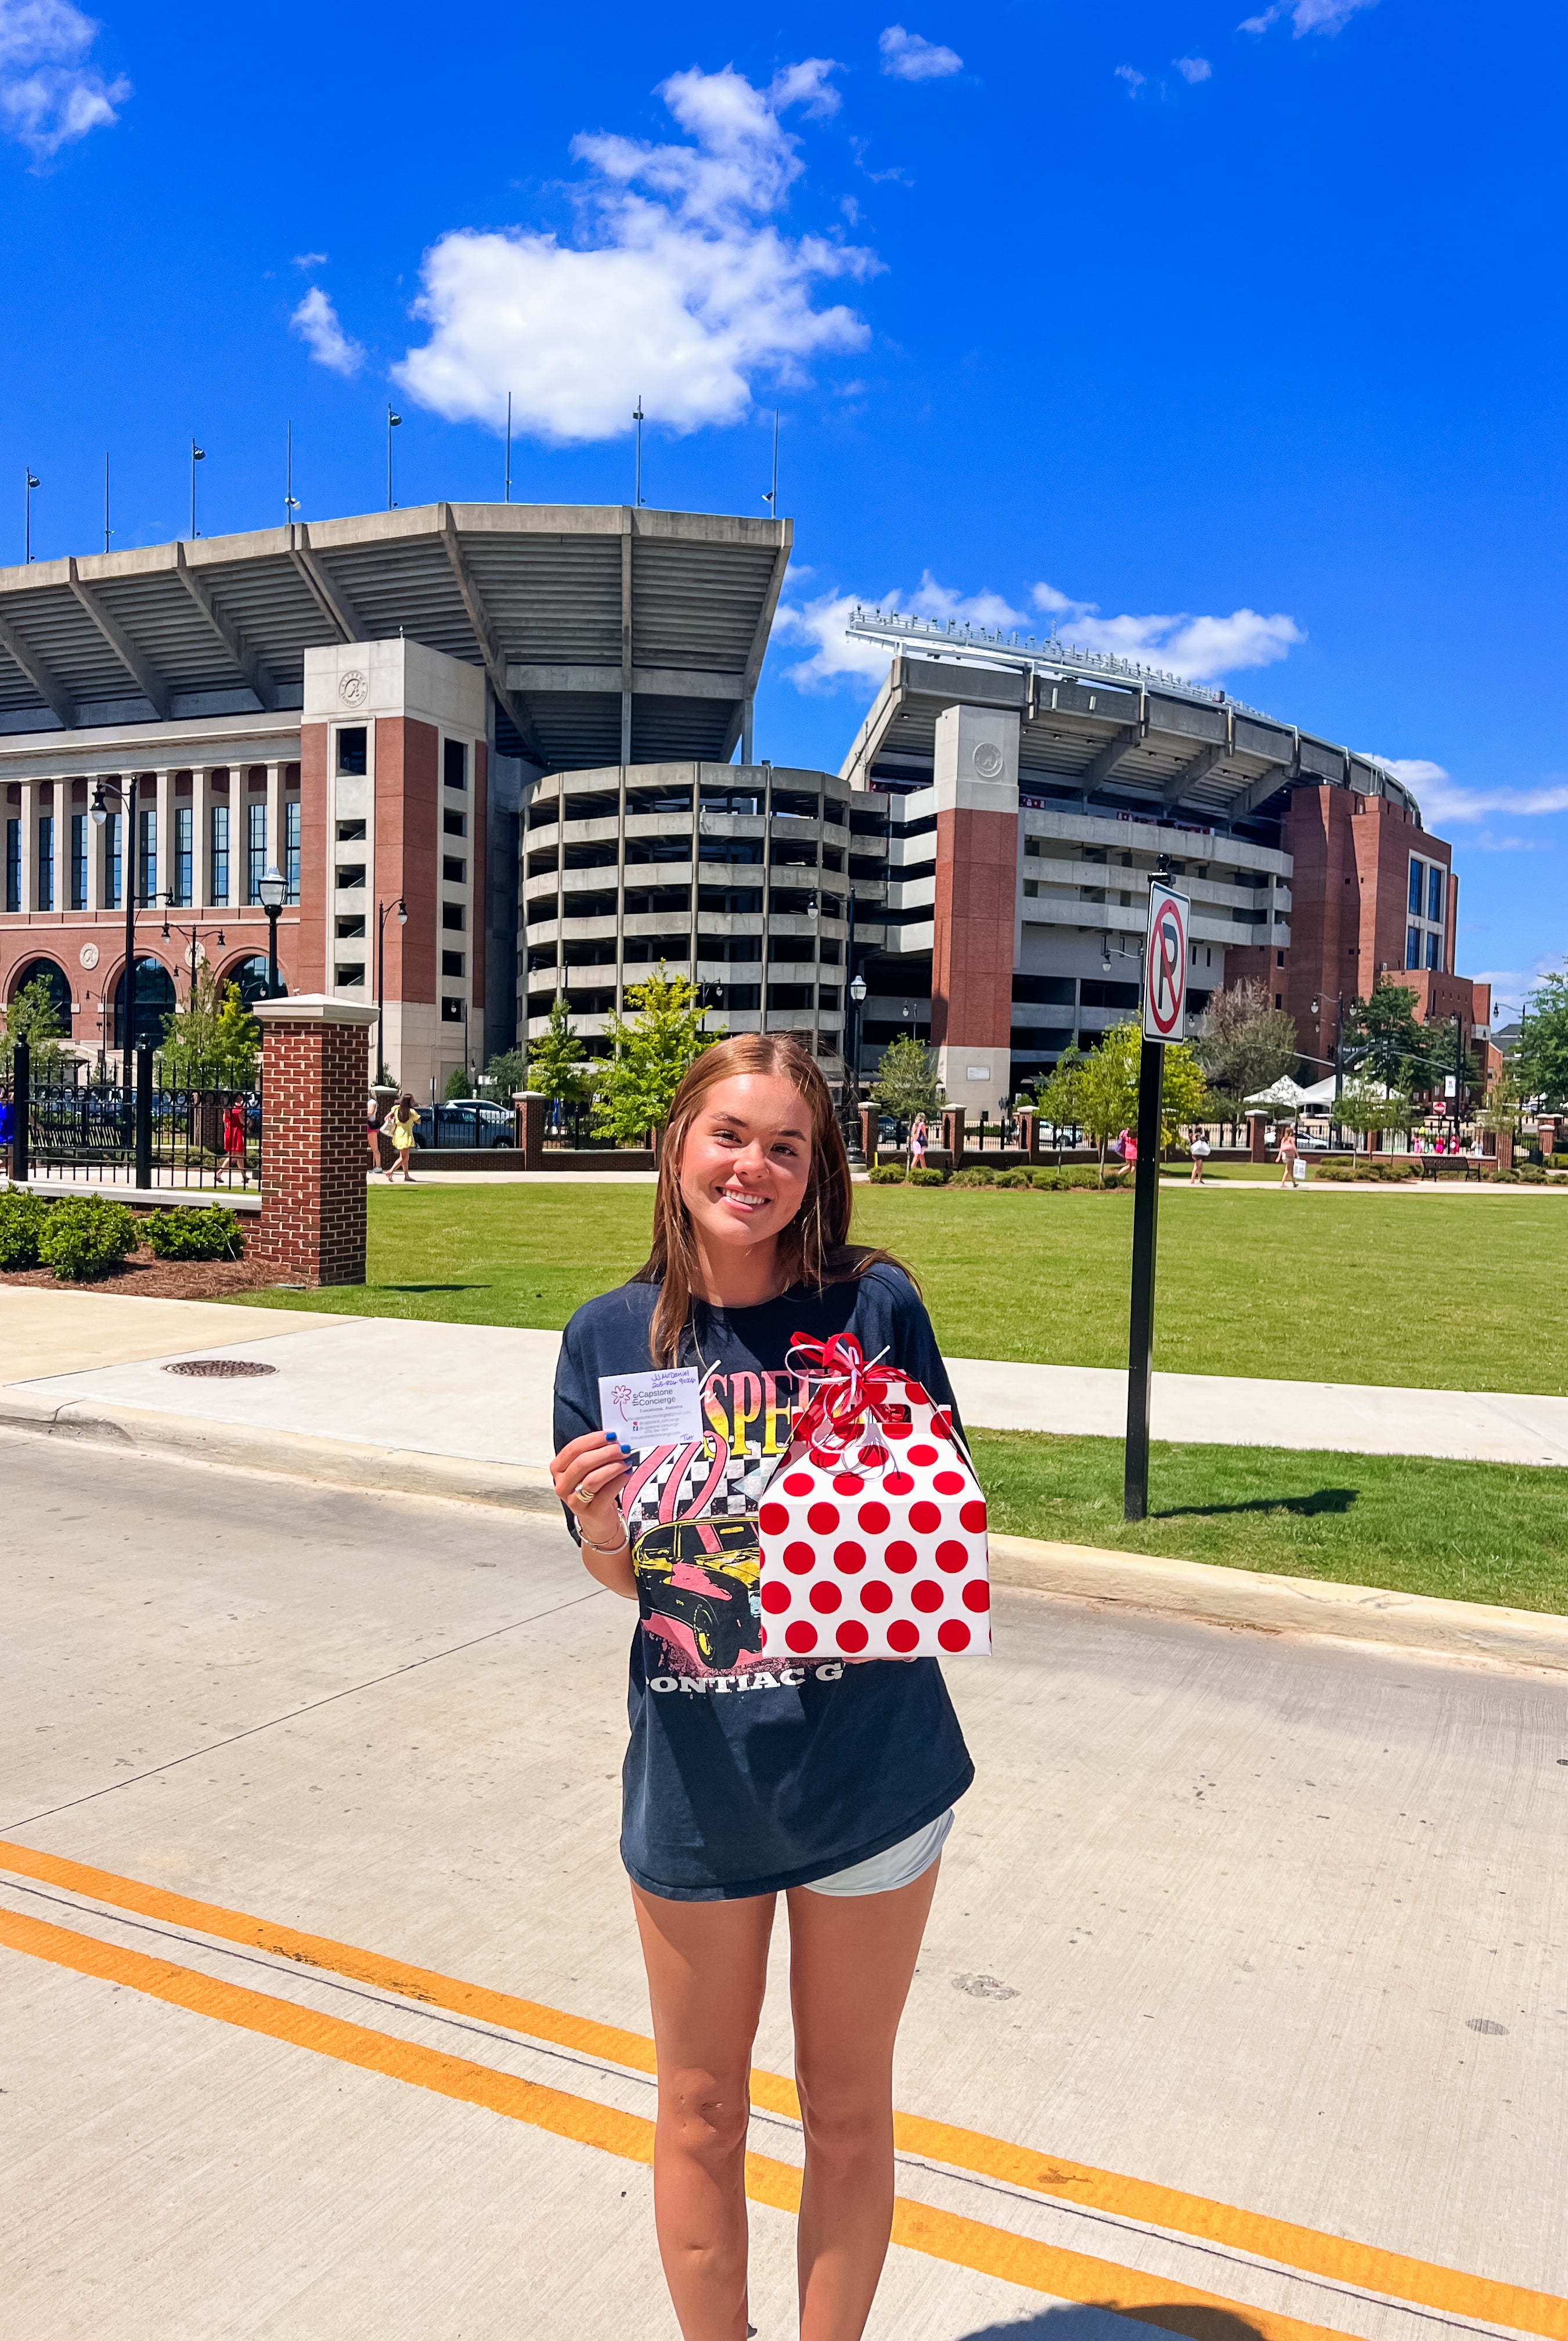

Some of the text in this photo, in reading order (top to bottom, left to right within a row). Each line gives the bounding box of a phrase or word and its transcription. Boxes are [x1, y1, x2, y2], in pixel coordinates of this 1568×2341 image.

[639, 1389, 673, 1398] Capstone
[639, 1396, 676, 1406] Concierge
[646, 1662, 846, 1693] ONTIAC G
